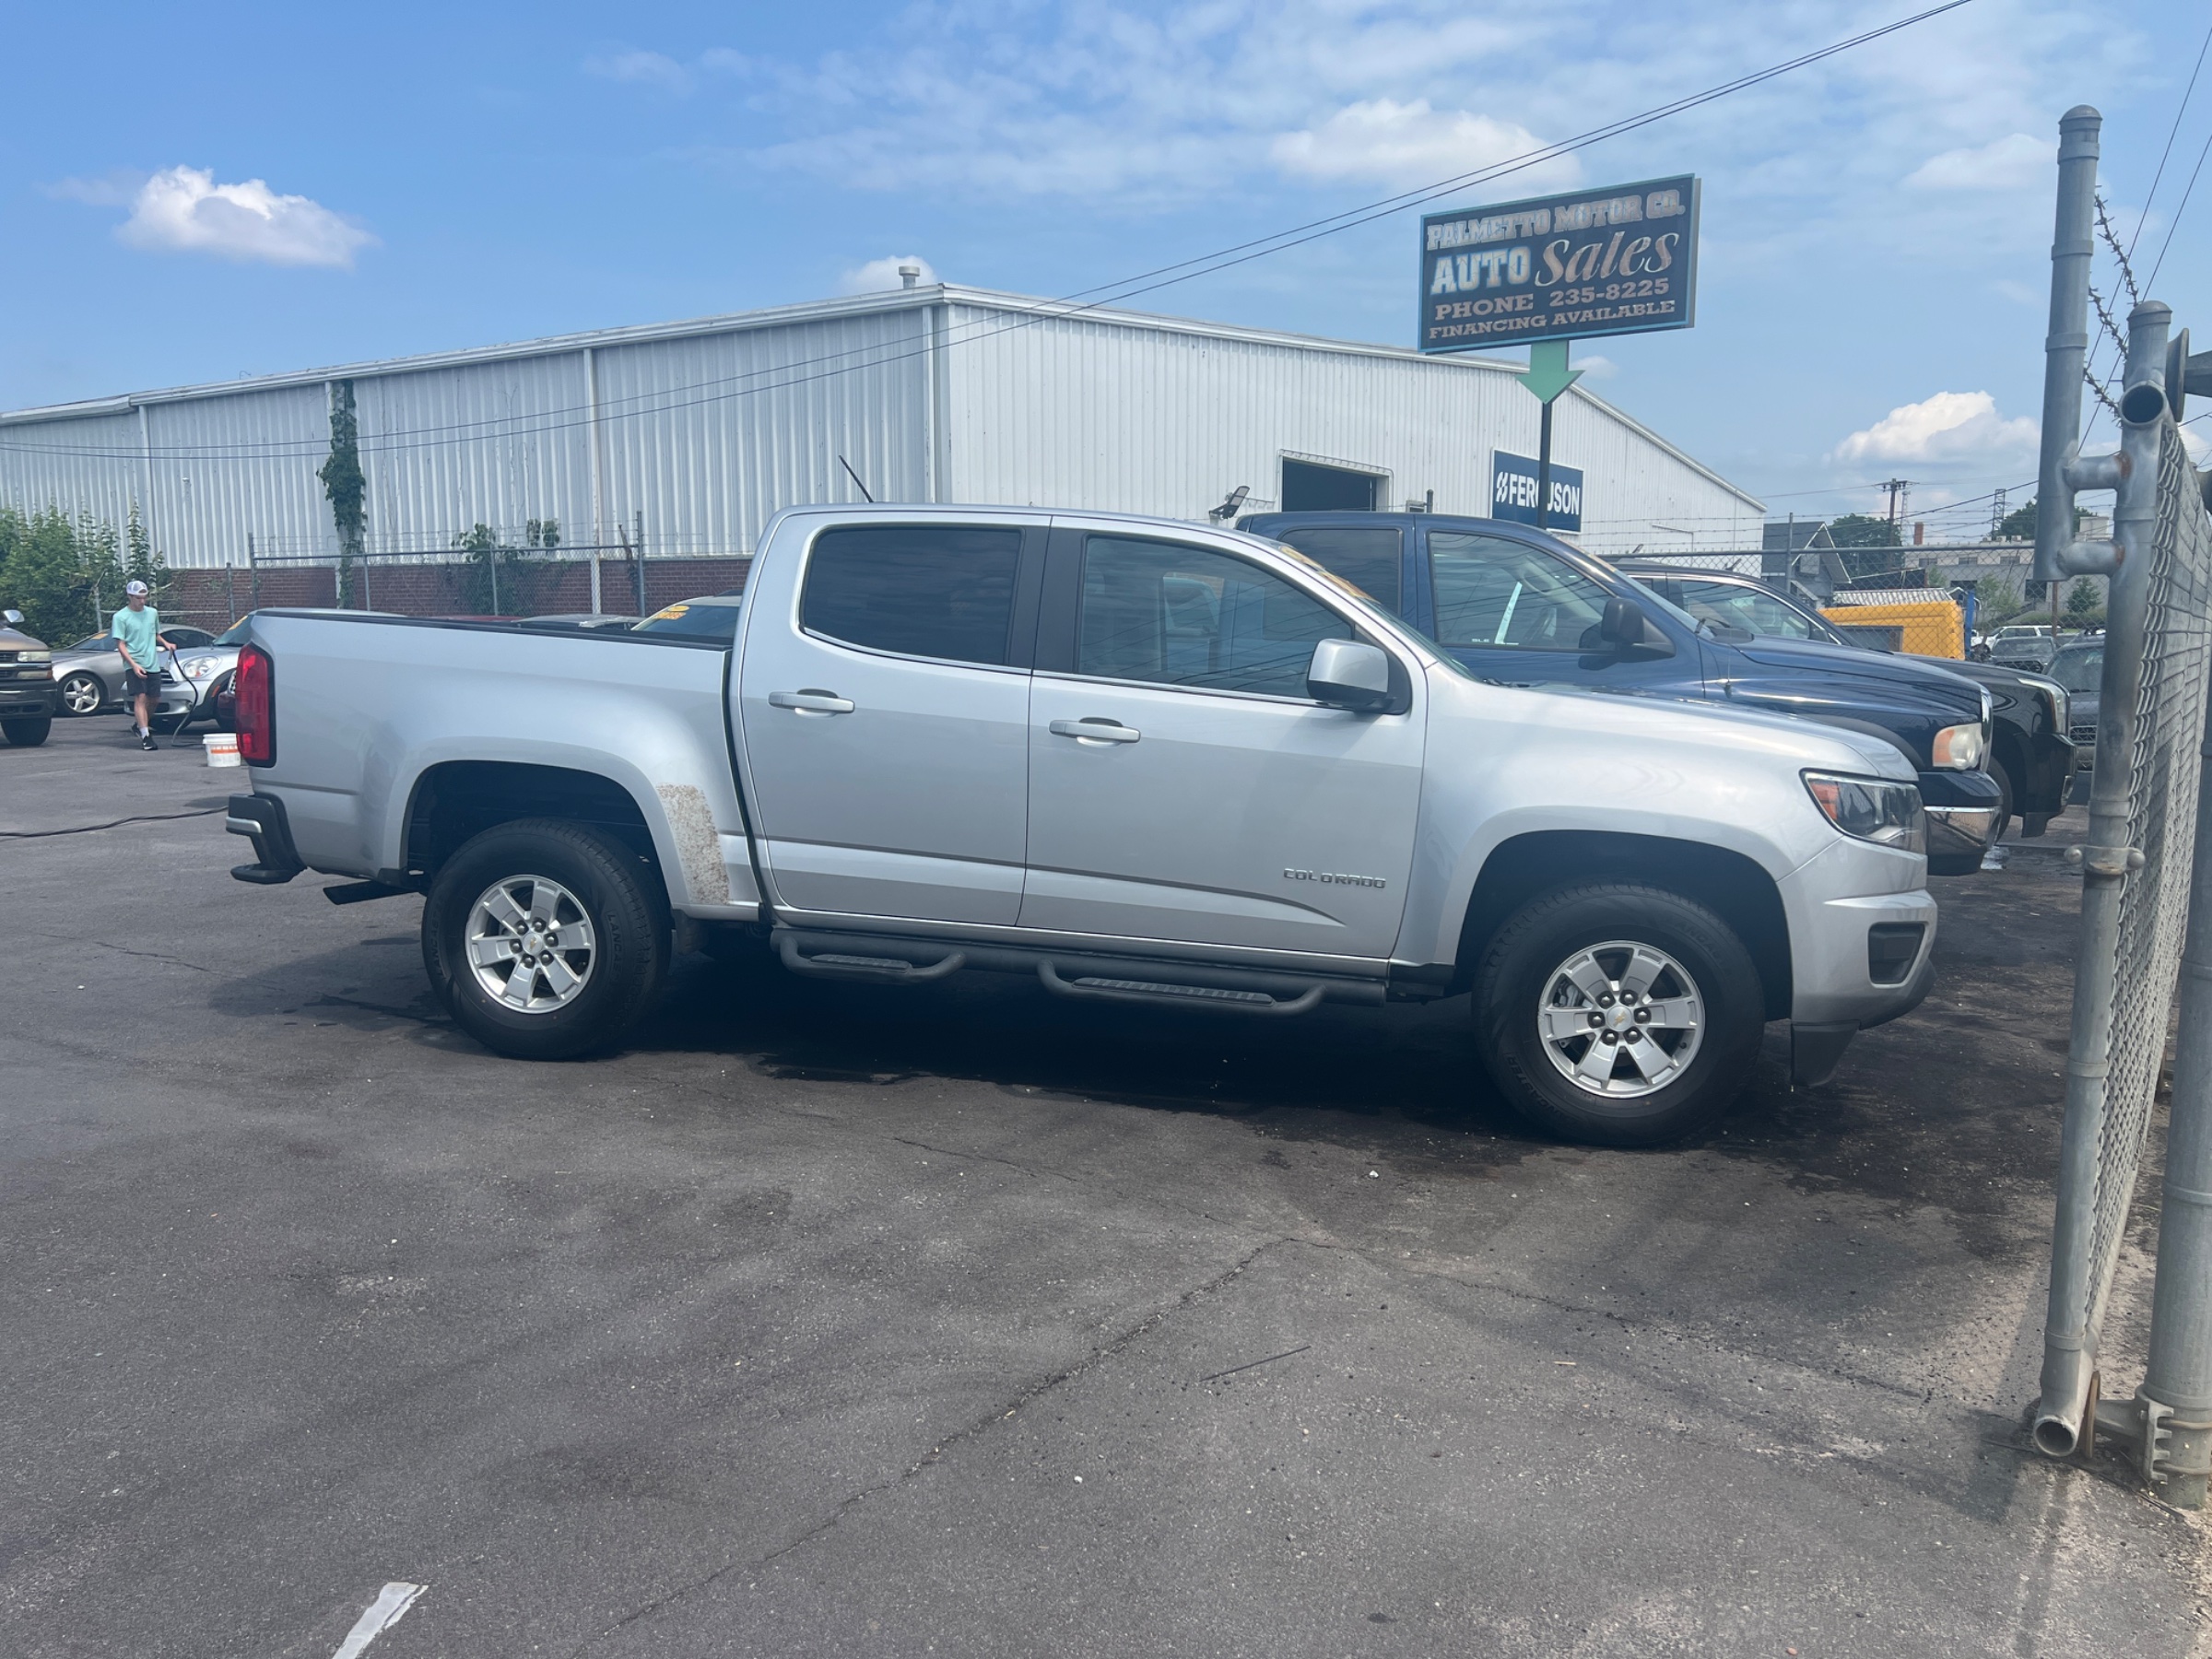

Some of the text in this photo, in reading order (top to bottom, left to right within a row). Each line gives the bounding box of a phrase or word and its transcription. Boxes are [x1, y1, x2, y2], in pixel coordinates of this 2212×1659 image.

[1427, 189, 1686, 251] PALMETTO MOTOR CO.
[1430, 230, 1679, 295] AUTO Sales
[1429, 300, 1676, 339] FINANCING AVAILABLE
[1435, 277, 1670, 321] PHONE 235-8225
[1283, 868, 1386, 888] COLORADO
